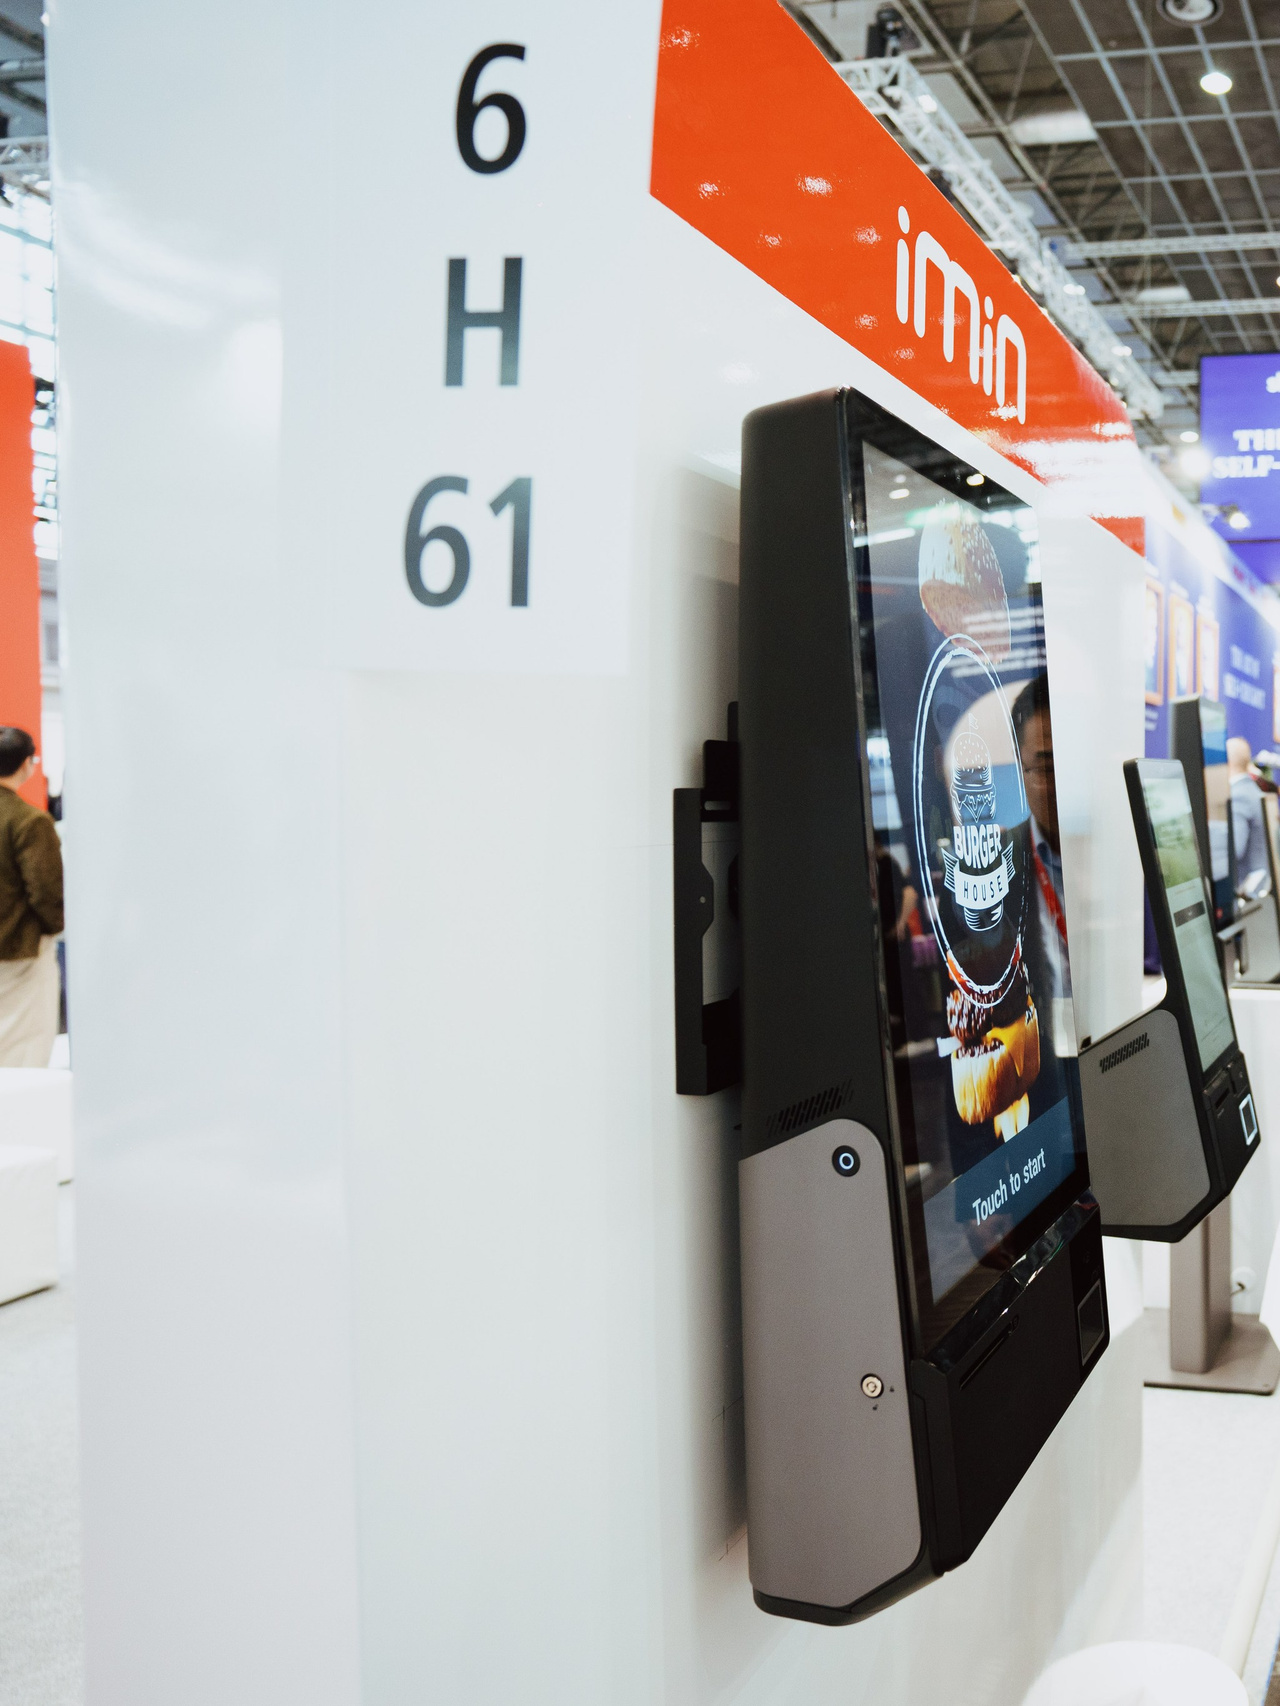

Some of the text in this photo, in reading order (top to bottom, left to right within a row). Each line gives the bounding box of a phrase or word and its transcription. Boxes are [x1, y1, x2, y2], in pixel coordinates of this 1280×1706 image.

[456, 41, 527, 174] 6
[444, 256, 523, 387] H
[404, 475, 532, 608] 61
[953, 823, 1002, 869] BURGER
[963, 874, 1003, 902] HOUSE
[972, 1148, 1046, 1226] Touch to start
